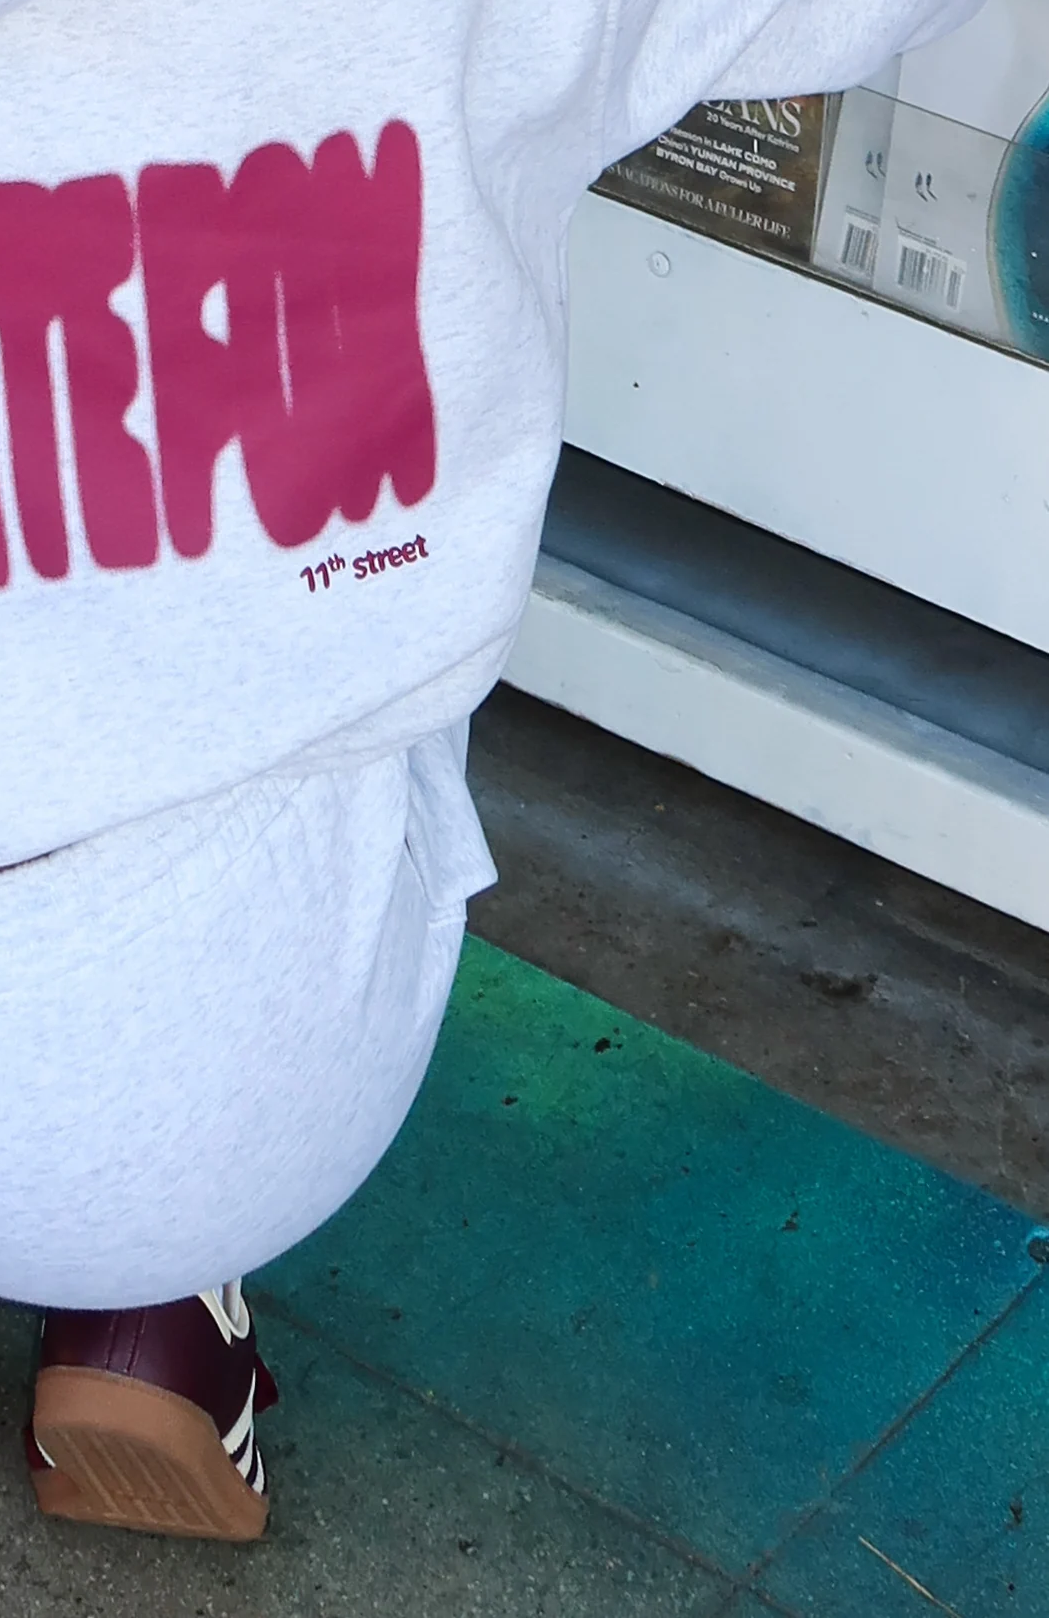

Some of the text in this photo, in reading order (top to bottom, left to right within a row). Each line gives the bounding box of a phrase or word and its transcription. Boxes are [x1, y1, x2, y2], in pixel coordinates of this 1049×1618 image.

[656, 146, 718, 177] BYRON BAY
[690, 145, 795, 193] YUNNAN PROVINCE
[300, 534, 429, 593] 11th street
